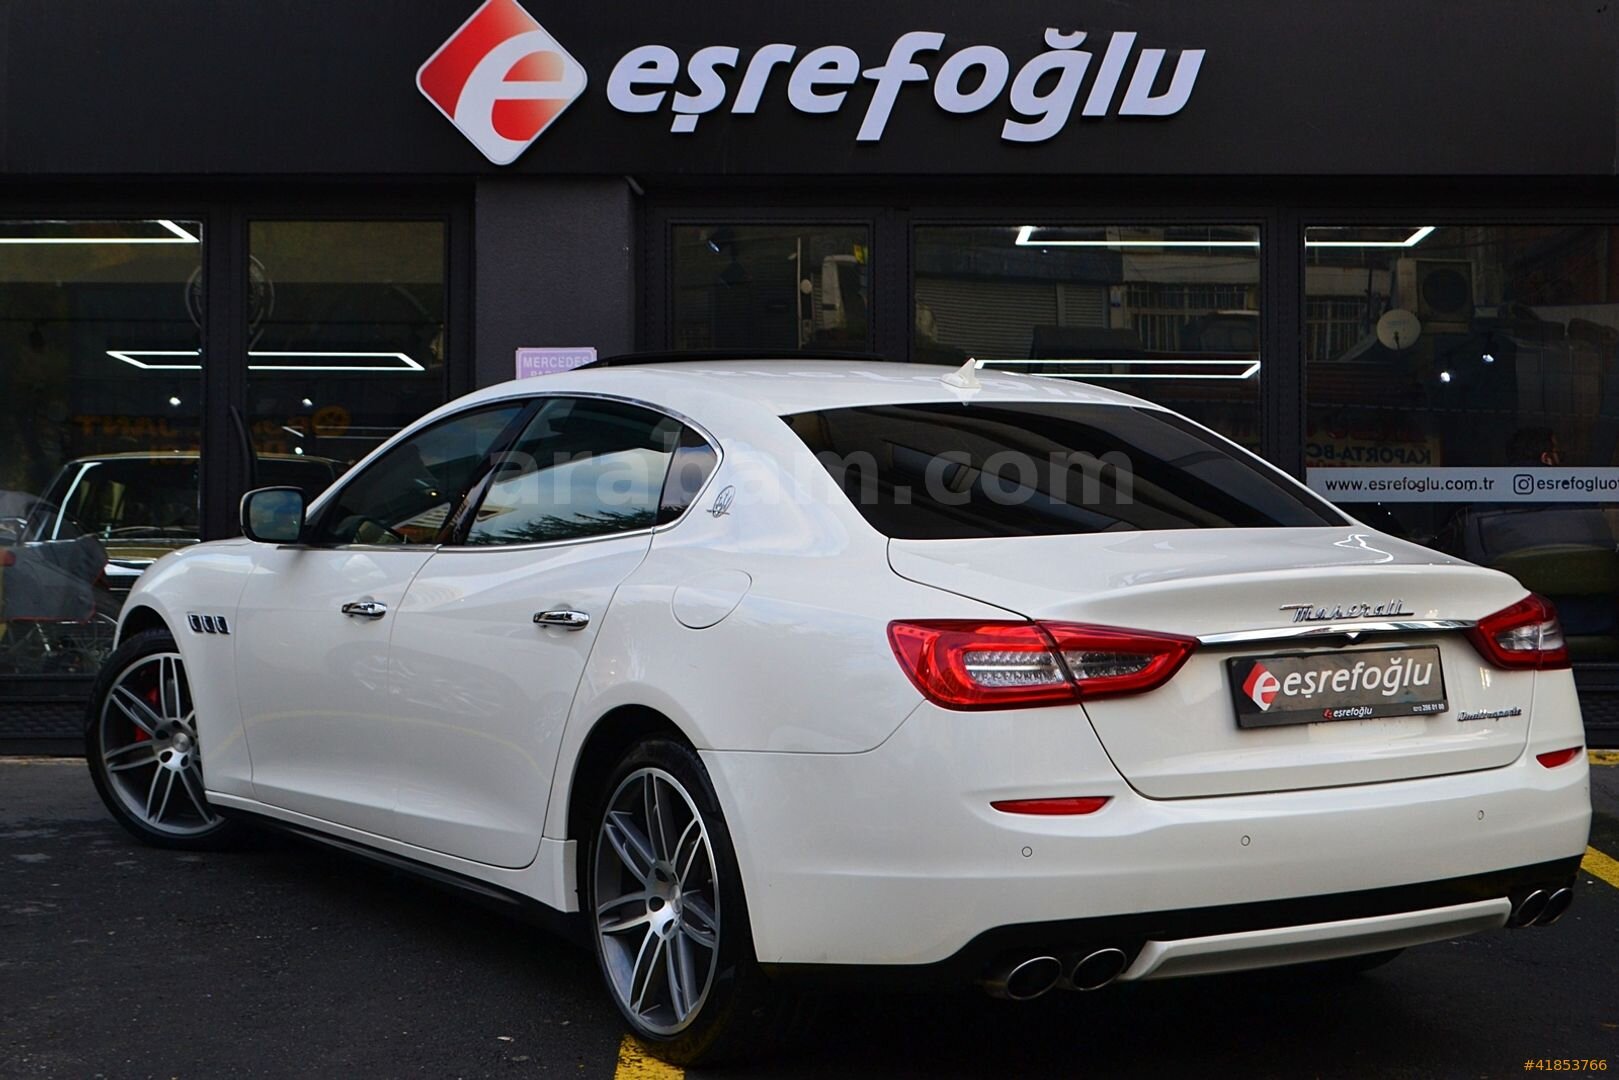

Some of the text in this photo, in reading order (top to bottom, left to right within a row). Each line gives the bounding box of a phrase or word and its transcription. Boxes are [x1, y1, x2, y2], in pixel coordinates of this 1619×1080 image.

[606, 27, 1206, 142] eşrefoğlu
[1325, 477, 1495, 493] www.esrefoglu.com.tr
[1536, 475, 1619, 492] esrefogluo
[1280, 599, 1414, 622] Maserati
[1283, 657, 1434, 698] eşrefoğlu
